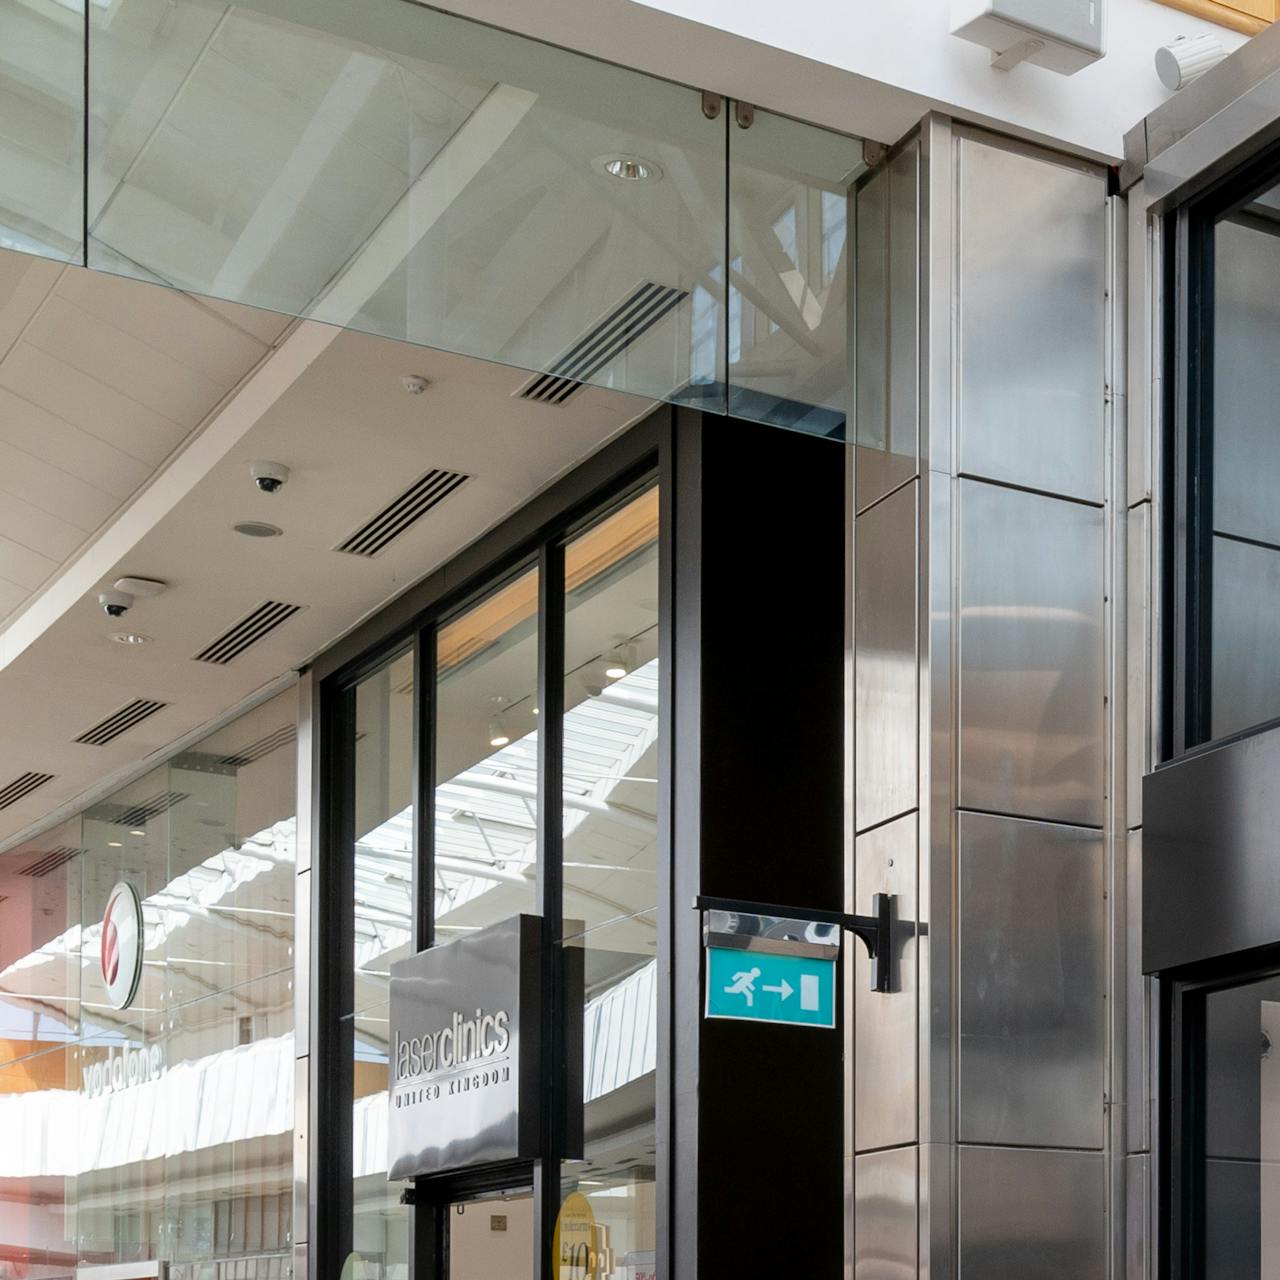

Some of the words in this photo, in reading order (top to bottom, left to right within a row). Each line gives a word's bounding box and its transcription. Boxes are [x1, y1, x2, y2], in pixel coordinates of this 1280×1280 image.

[395, 1008, 510, 1081] laserclinics
[395, 1085, 441, 1109] UNITED
[449, 1066, 510, 1096] KINGDOM
